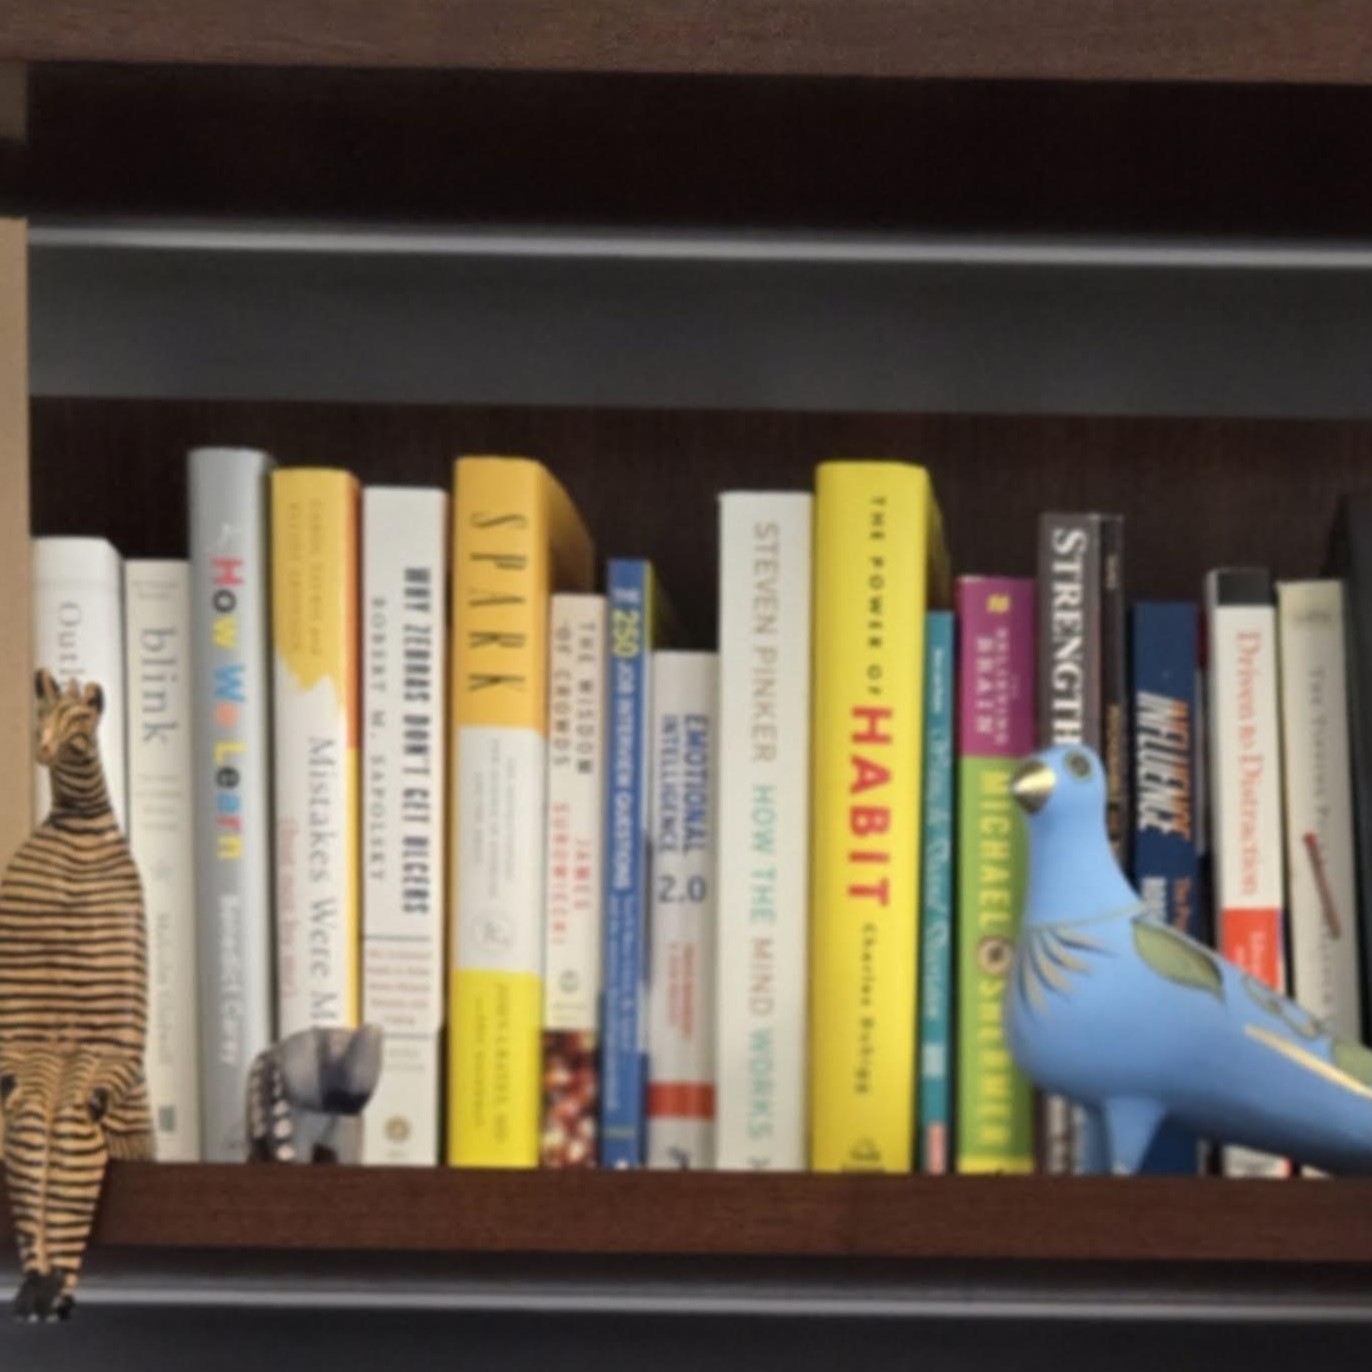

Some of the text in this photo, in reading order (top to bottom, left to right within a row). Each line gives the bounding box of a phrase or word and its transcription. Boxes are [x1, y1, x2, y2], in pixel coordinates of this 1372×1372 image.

[869, 495, 887, 542] THE
[369, 595, 388, 694] ROBERT
[467, 510, 530, 694] SPARK
[610, 608, 639, 659] 250
[867, 555, 886, 650] POWER
[140, 626, 178, 745] blink
[212, 556, 248, 861] How We Learn
[553, 624, 573, 767] OF CROWDS
[576, 621, 596, 775] THE WISDOM
[616, 661, 634, 694] JOB
[866, 663, 884, 697] OF
[975, 636, 994, 735] BRAIN
[401, 566, 431, 916] WHY ZEBRAS DON'T GET ULCERS
[614, 698, 634, 787] INTERVIEW
[659, 714, 681, 853] INTELLIGENCE
[682, 714, 708, 855] EMOTIONAL
[1136, 689, 1191, 843] INFLUENCE
[1235, 631, 1265, 896] Driven to Distraction
[305, 736, 336, 885] Mistakes
[369, 754, 388, 884] SAPOLSKY
[612, 792, 633, 890] QUESTIONS
[747, 520, 781, 1141] STEVEN PINKER HOW THE MIND WORKS
[848, 705, 895, 908] HABIT
[979, 769, 1011, 927] MICHAEL
[572, 838, 593, 911] JAMES
[657, 874, 705, 904] 2.0
[308, 899, 339, 980] Were
[858, 922, 877, 1007] Charles
